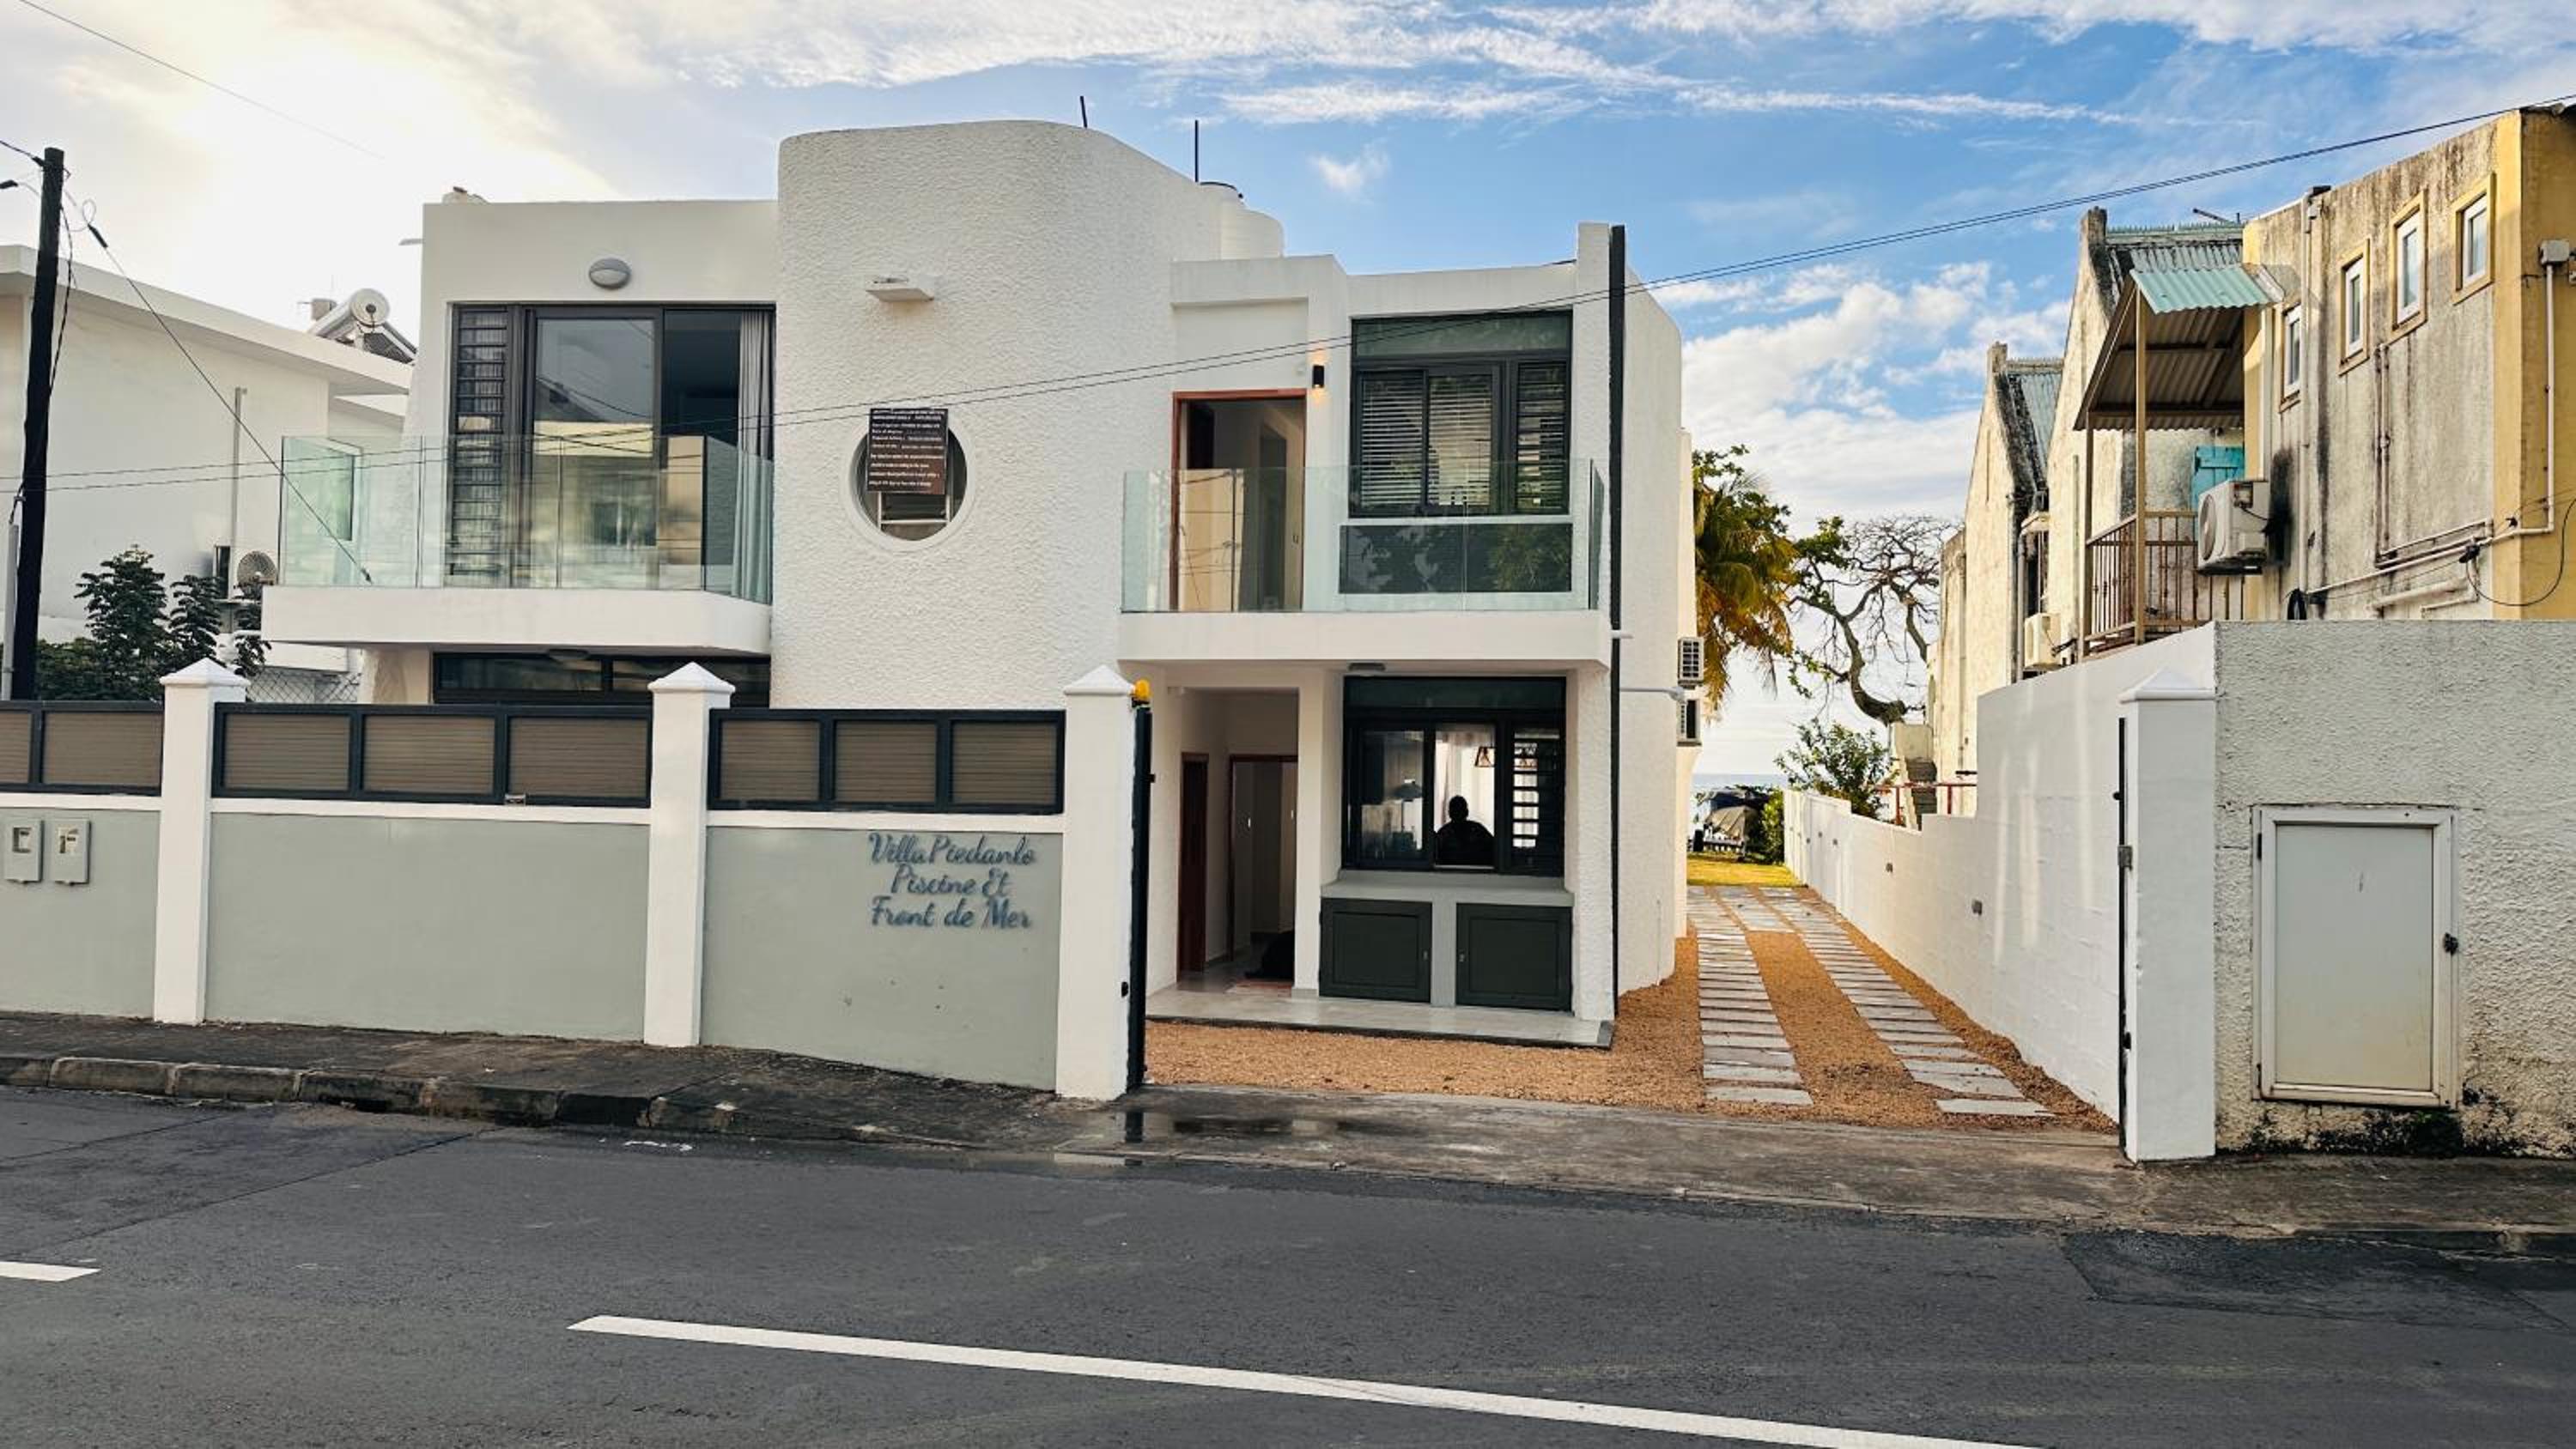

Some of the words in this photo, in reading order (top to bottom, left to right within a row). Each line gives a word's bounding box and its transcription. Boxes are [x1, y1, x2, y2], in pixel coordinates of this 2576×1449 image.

[869, 833, 927, 864] Villa
[890, 864, 976, 894] Piscine
[981, 867, 1011, 897] Et
[872, 896, 934, 927] Front
[944, 898, 974, 928] de
[982, 899, 1032, 929] Mer
